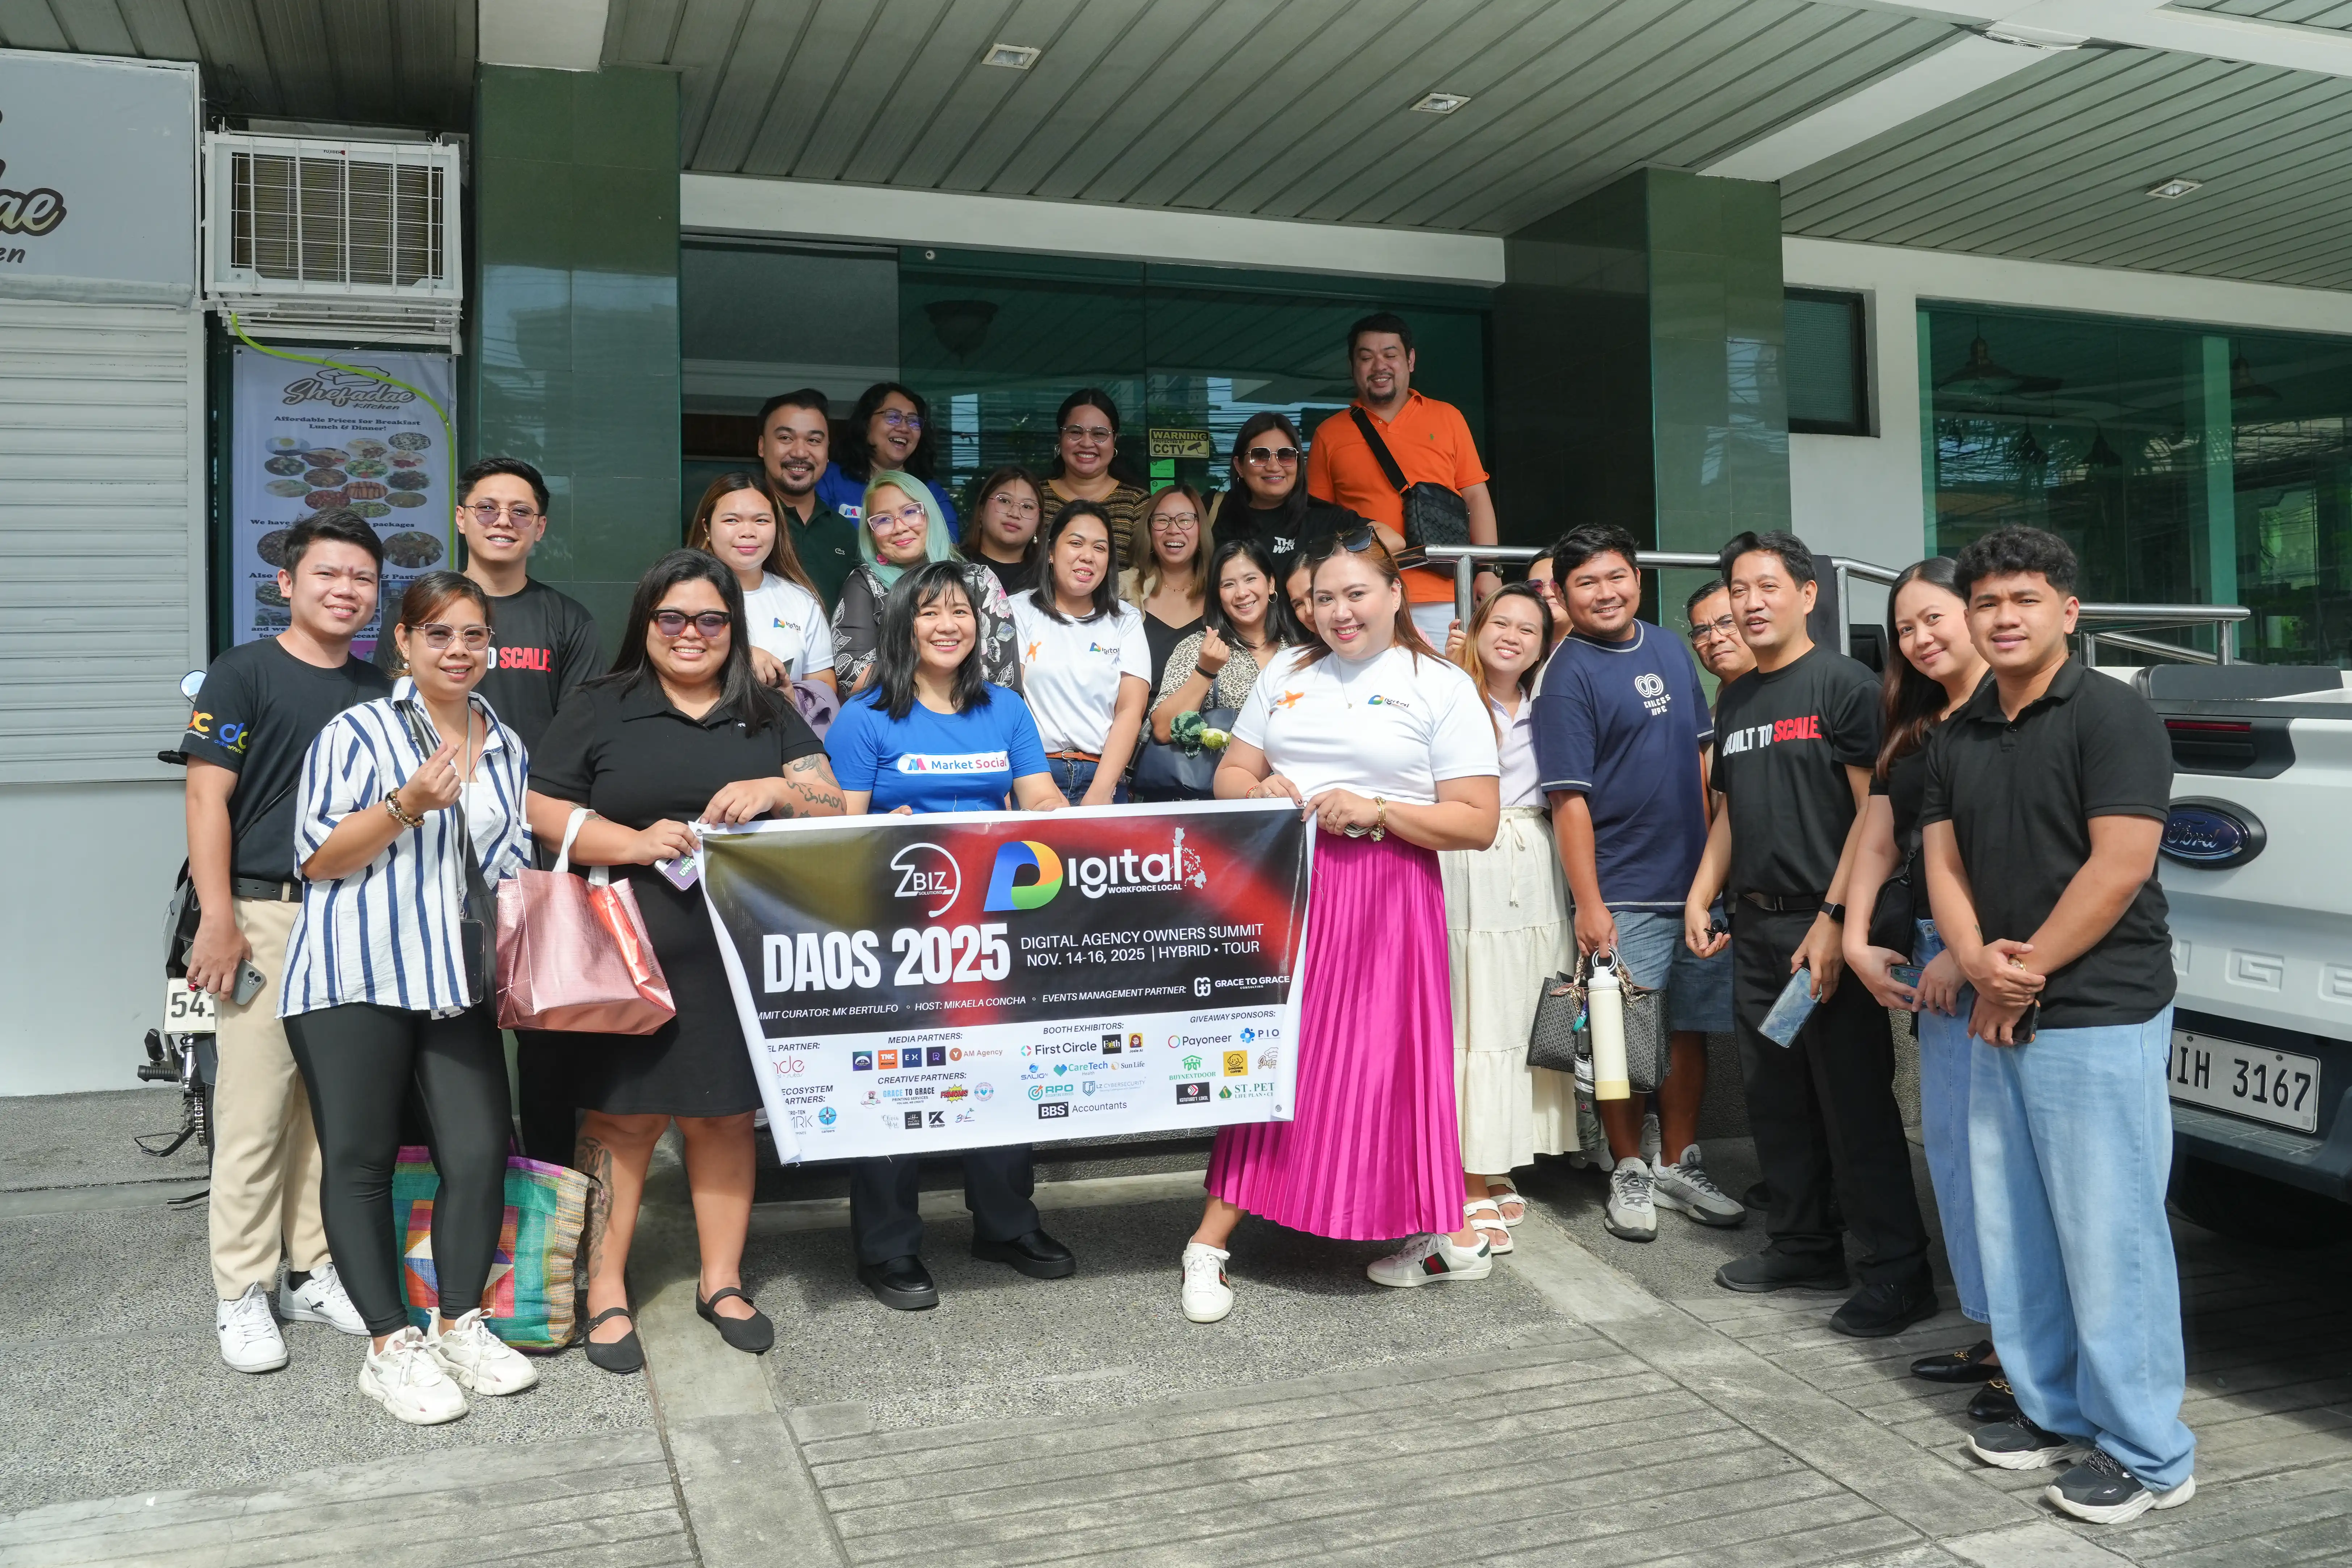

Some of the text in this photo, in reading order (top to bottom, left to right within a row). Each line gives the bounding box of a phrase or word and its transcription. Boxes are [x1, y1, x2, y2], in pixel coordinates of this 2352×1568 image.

[352, 402, 400, 410] Kitchen
[1153, 431, 1207, 440] WARNING
[1153, 444, 1185, 454] CCTV
[1274, 537, 1296, 546] THE
[1273, 544, 1295, 554] WAY
[487, 647, 552, 672] O SCALE
[1723, 716, 1822, 757] BUILT TO SCALE
[932, 757, 1007, 769] Market Social
[2167, 818, 2221, 849] Ford
[1108, 885, 1157, 894] WORKFORCE
[1020, 923, 1264, 950] DIGITAL AGENCY OWNERS SUMMIT
[763, 923, 1011, 993] DAOS 2025
[1027, 941, 1260, 967] NOV. 14-16, 2025 HYBRID TOUR
[1215, 978, 1244, 988] GRACE
[1259, 976, 1290, 984] GRACE
[781, 1009, 831, 1018] CURATOR:
[833, 1007, 848, 1016] MK
[849, 1004, 898, 1015] BERTULFO
[915, 1002, 943, 1011] HOST:
[944, 998, 985, 1009] MIKAELA
[986, 996, 1026, 1007] CONCHA
[1042, 992, 1078, 1003] EVENTS
[1079, 989, 1144, 1001] MANAGEMENT
[1145, 985, 1186, 996] PARTNER:
[1190, 1011, 1276, 1023] GIVEAWAY SPONSORS:
[1074, 1023, 1124, 1032] EXHIBITORS:
[917, 1033, 963, 1042] PARTNERS:
[1182, 1035, 1232, 1047] Payoneer
[778, 1043, 820, 1052] PARTNER:
[1035, 1041, 1097, 1055] First Circle
[1103, 1040, 1120, 1048] Faith
[977, 1049, 1003, 1057] Agency
[1068, 1061, 1108, 1072] CareTech
[878, 1073, 967, 1085] CREATIVE PARTNERS:
[1169, 1072, 1216, 1081] BUYNEXTDOOR
[1045, 1084, 1074, 1093] RPO
[1254, 1082, 1275, 1092] PET
[2233, 1057, 2312, 1112] 3167
[781, 1085, 833, 1095] ECOSYSTEM
[915, 1087, 935, 1095] GRACE
[785, 1095, 826, 1105] ARTNERS:
[1041, 1101, 1127, 1117] BBS Accountants
